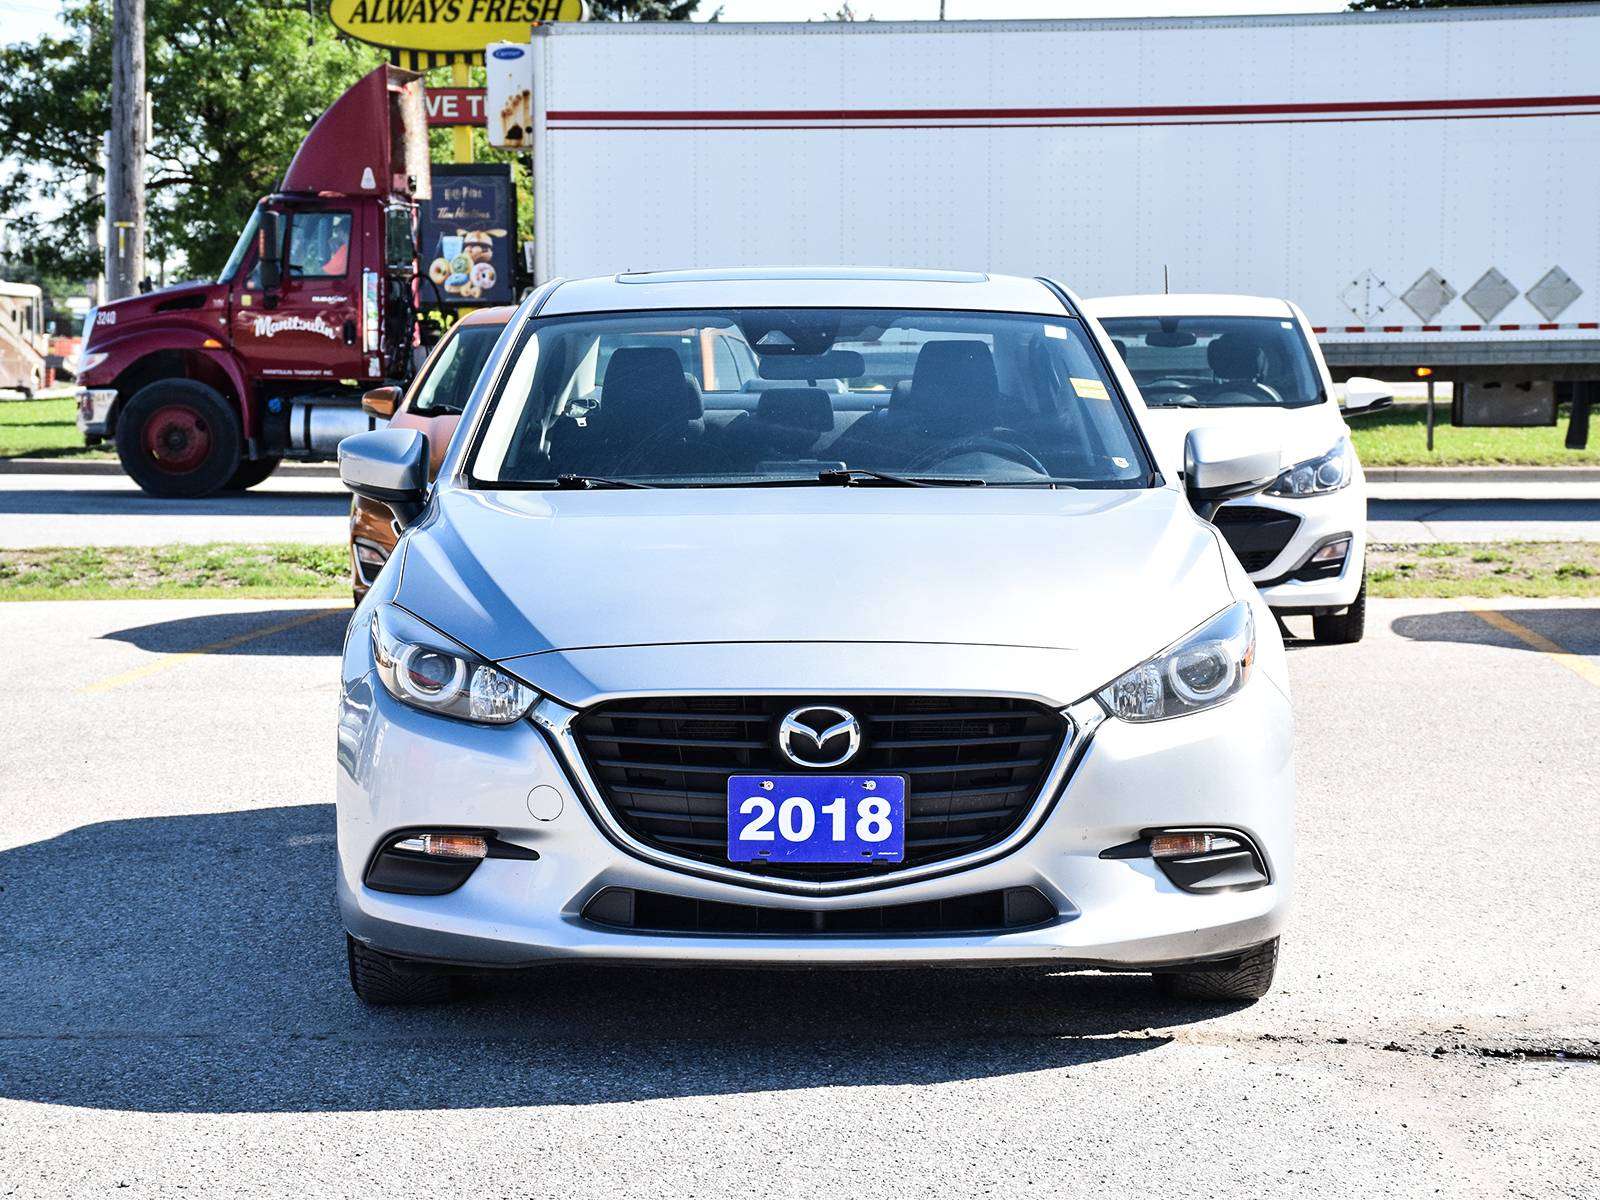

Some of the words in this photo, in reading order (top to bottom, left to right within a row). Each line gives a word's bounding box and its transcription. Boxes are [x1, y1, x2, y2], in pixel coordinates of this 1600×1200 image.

[348, 0, 461, 24] ALWAYS
[466, 0, 562, 23] FRESH
[465, 95, 488, 117] T
[254, 315, 337, 339] Manitoulin
[738, 796, 893, 842] 2018
